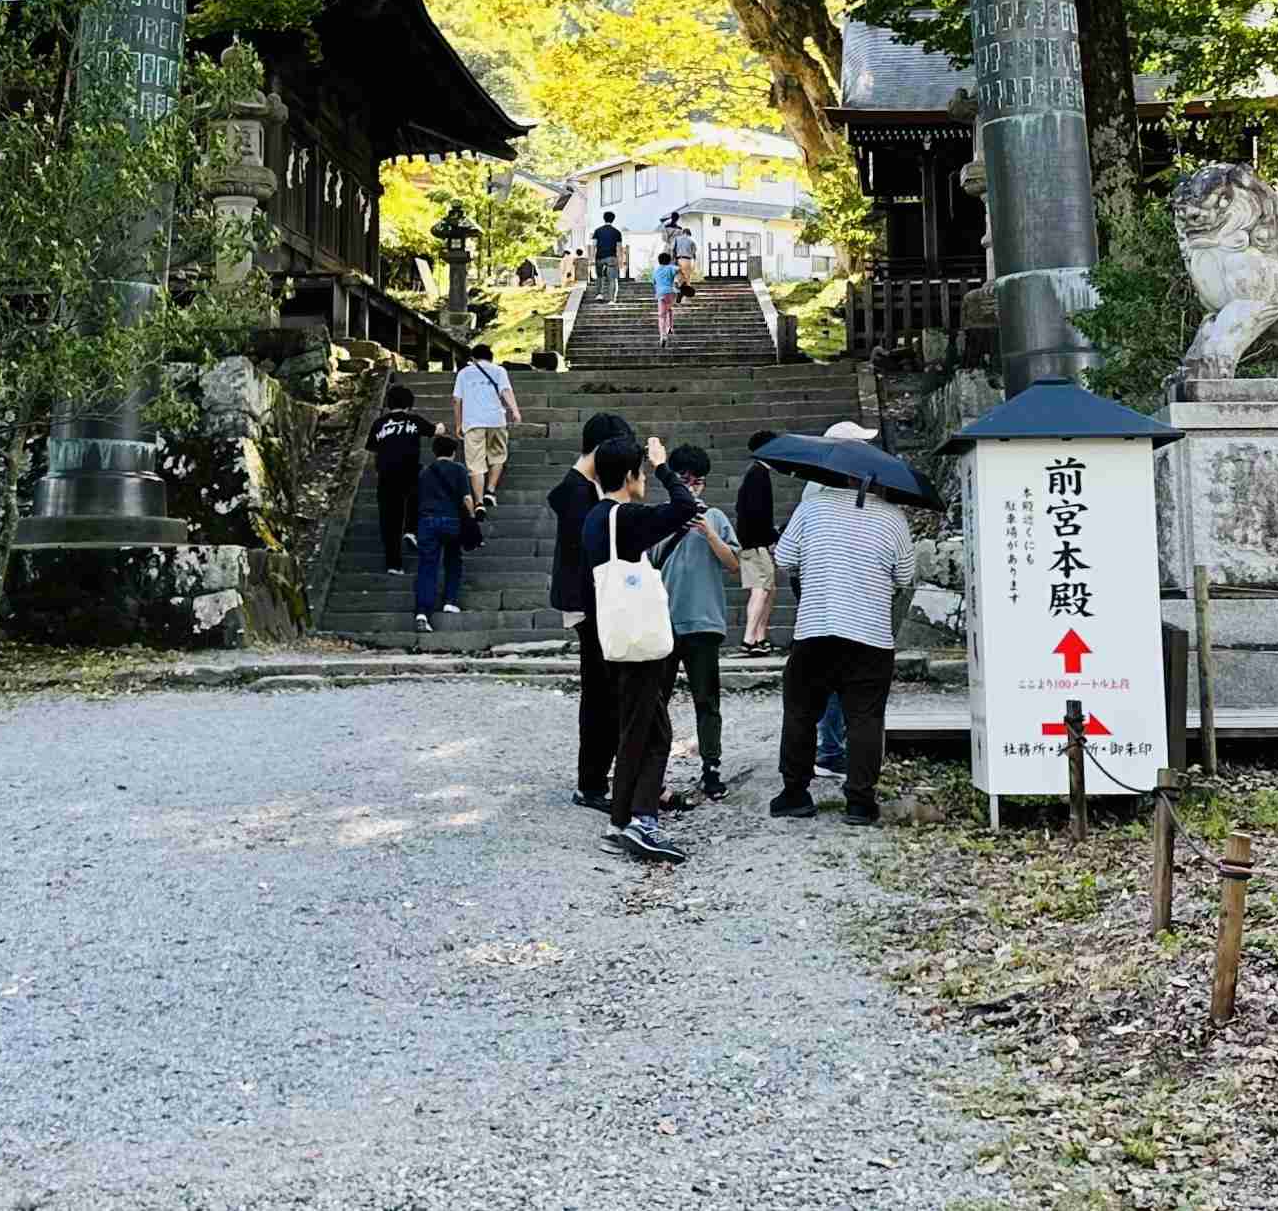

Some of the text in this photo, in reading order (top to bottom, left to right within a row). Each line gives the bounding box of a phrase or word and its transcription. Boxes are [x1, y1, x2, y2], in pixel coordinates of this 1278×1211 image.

[1045, 457, 1096, 618] 前宮本殿
[1003, 741, 1153, 757] 社務所・所・御朱印
